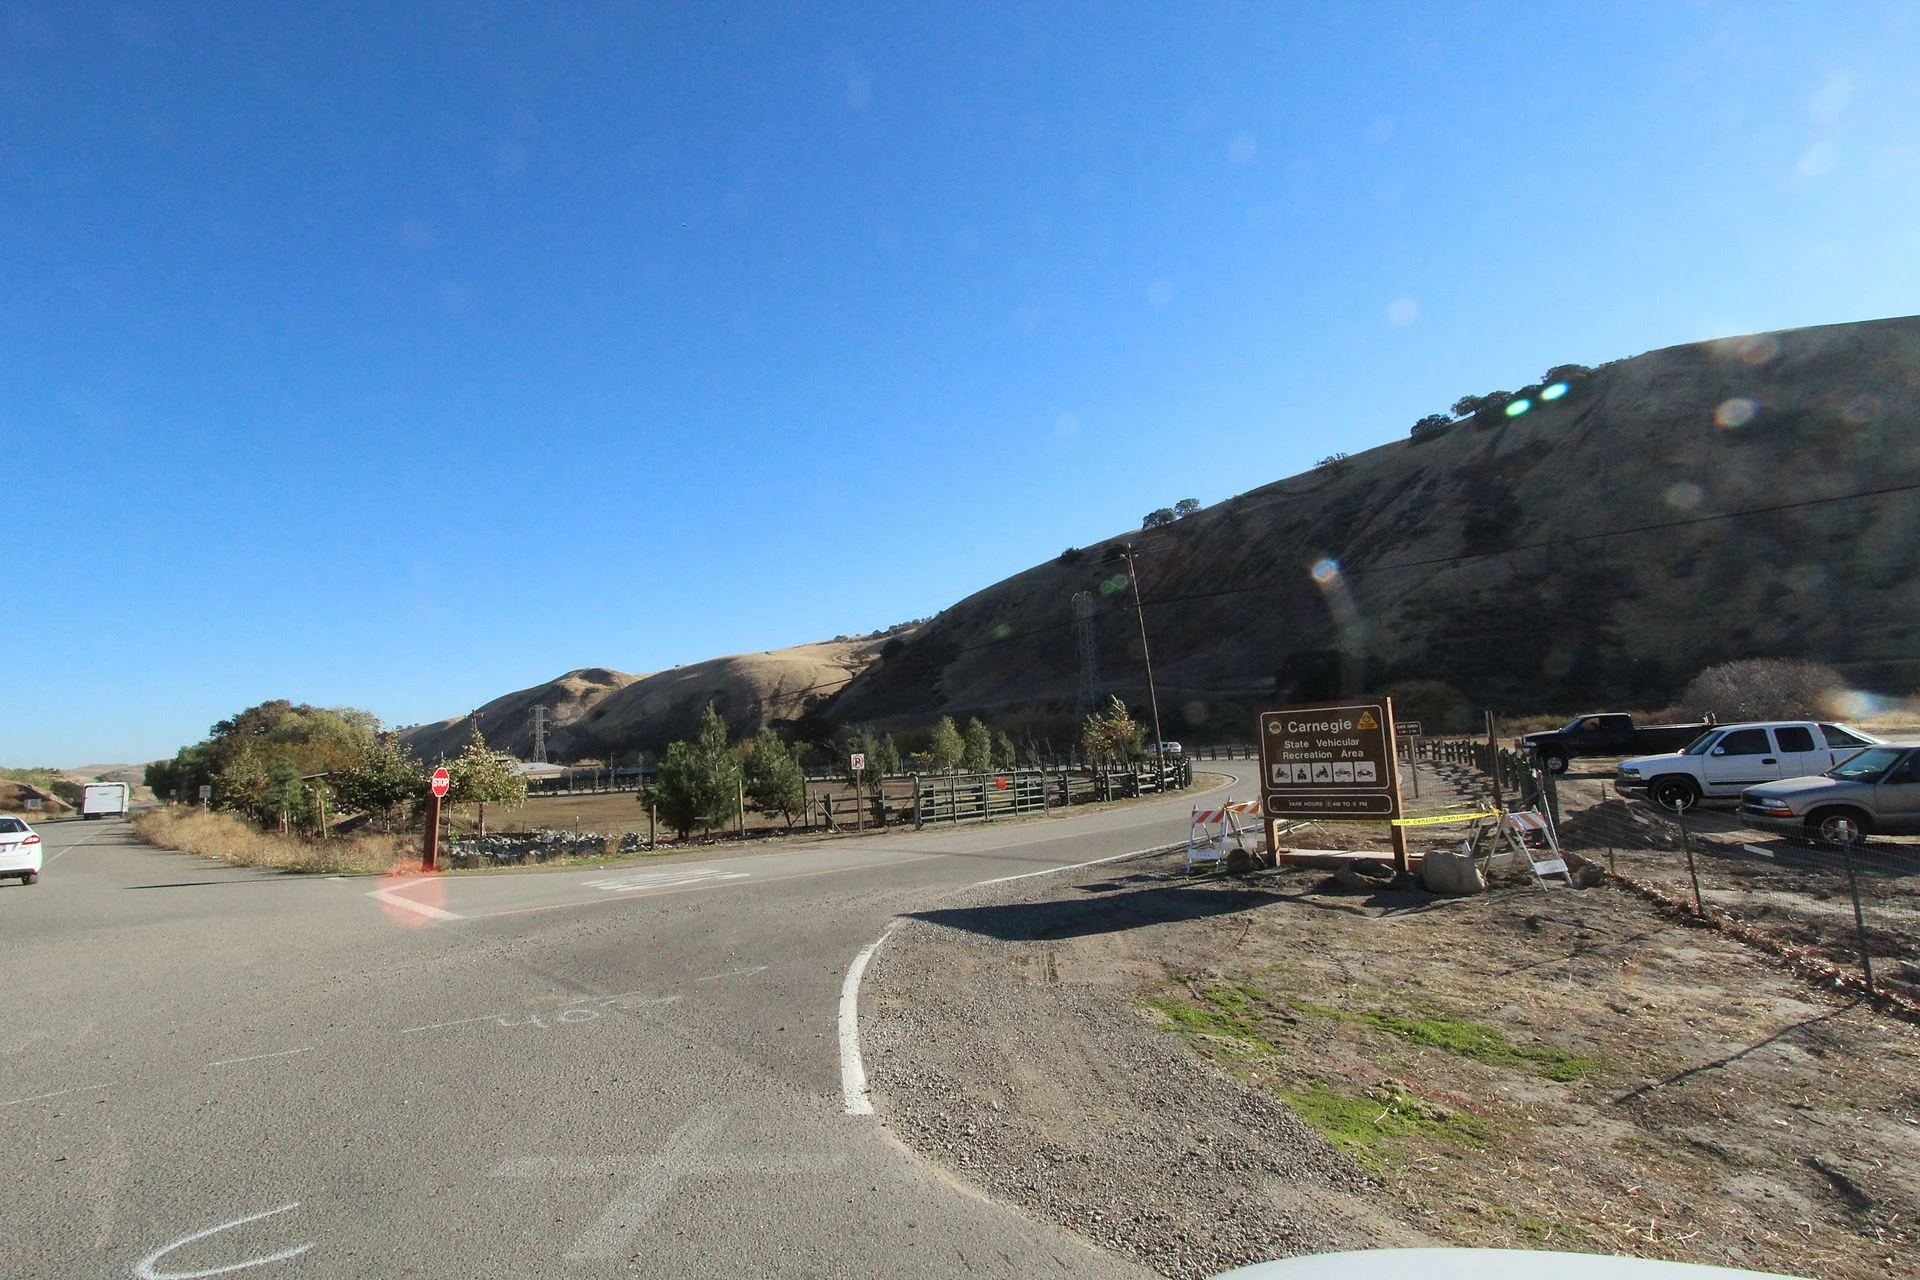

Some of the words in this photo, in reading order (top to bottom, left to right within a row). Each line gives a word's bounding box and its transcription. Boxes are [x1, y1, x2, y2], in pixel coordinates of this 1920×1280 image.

[1288, 718, 1352, 734] Carnegie
[1284, 740, 1309, 749] State
[1316, 738, 1360, 747] Vehicular
[1283, 751, 1333, 760] Recreation
[1341, 749, 1364, 758] Area
[432, 778, 449, 787] STOP
